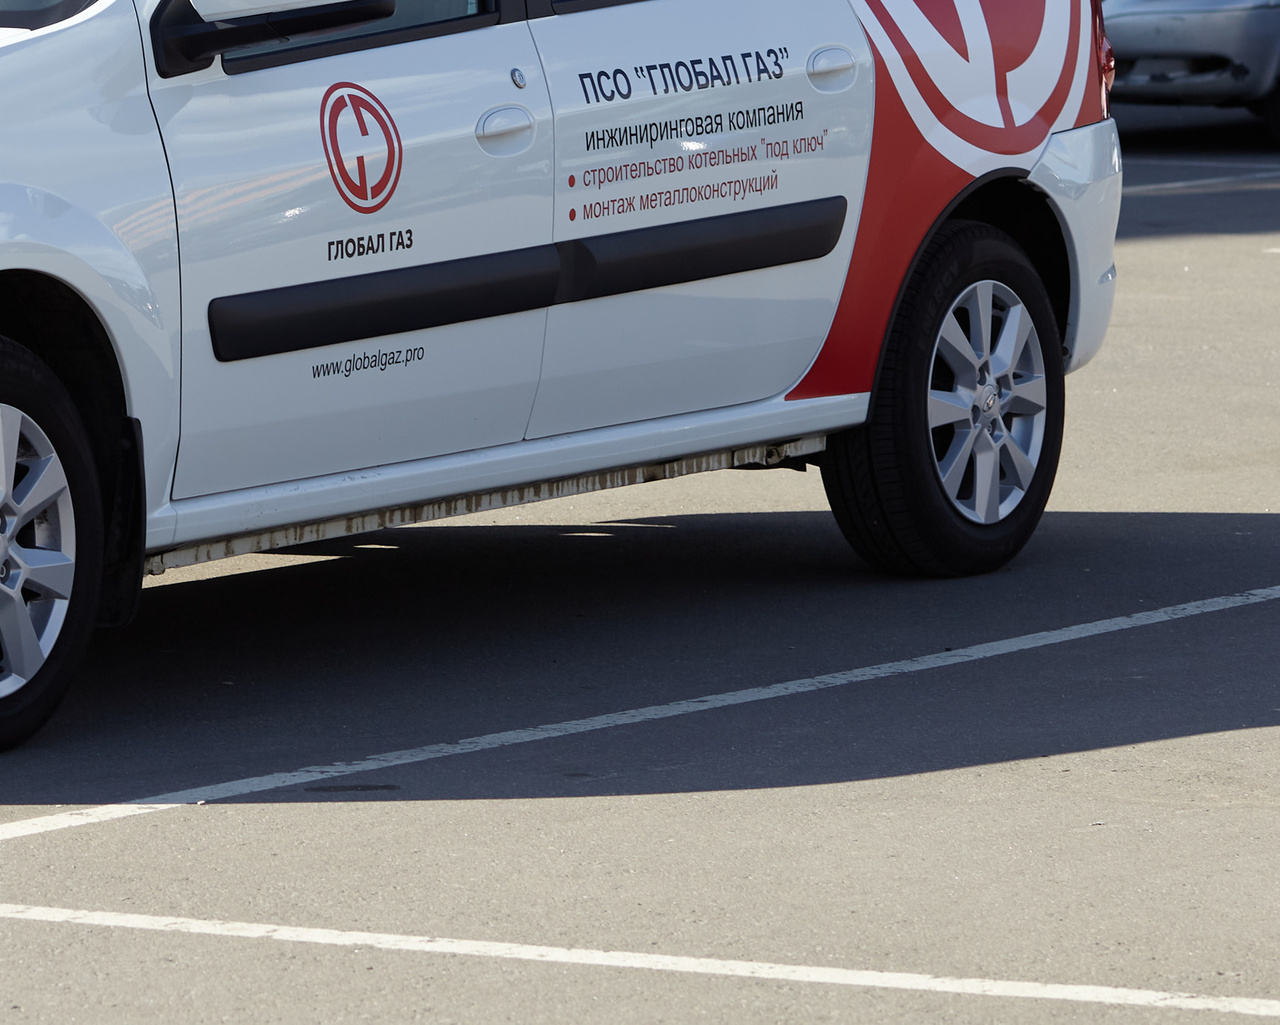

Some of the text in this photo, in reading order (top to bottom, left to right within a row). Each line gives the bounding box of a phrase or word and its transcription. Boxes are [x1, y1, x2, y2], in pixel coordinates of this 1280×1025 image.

[579, 67, 632, 104] ПСО
[585, 101, 804, 151] инжиниринговая компания
[583, 154, 684, 190] строительство
[688, 143, 757, 170] котельных
[583, 170, 778, 220] монтаж металлоконструкций
[327, 229, 413, 261] ГЛОБАЛ ГАЗ
[312, 345, 425, 378] www.globalgaz.pro
